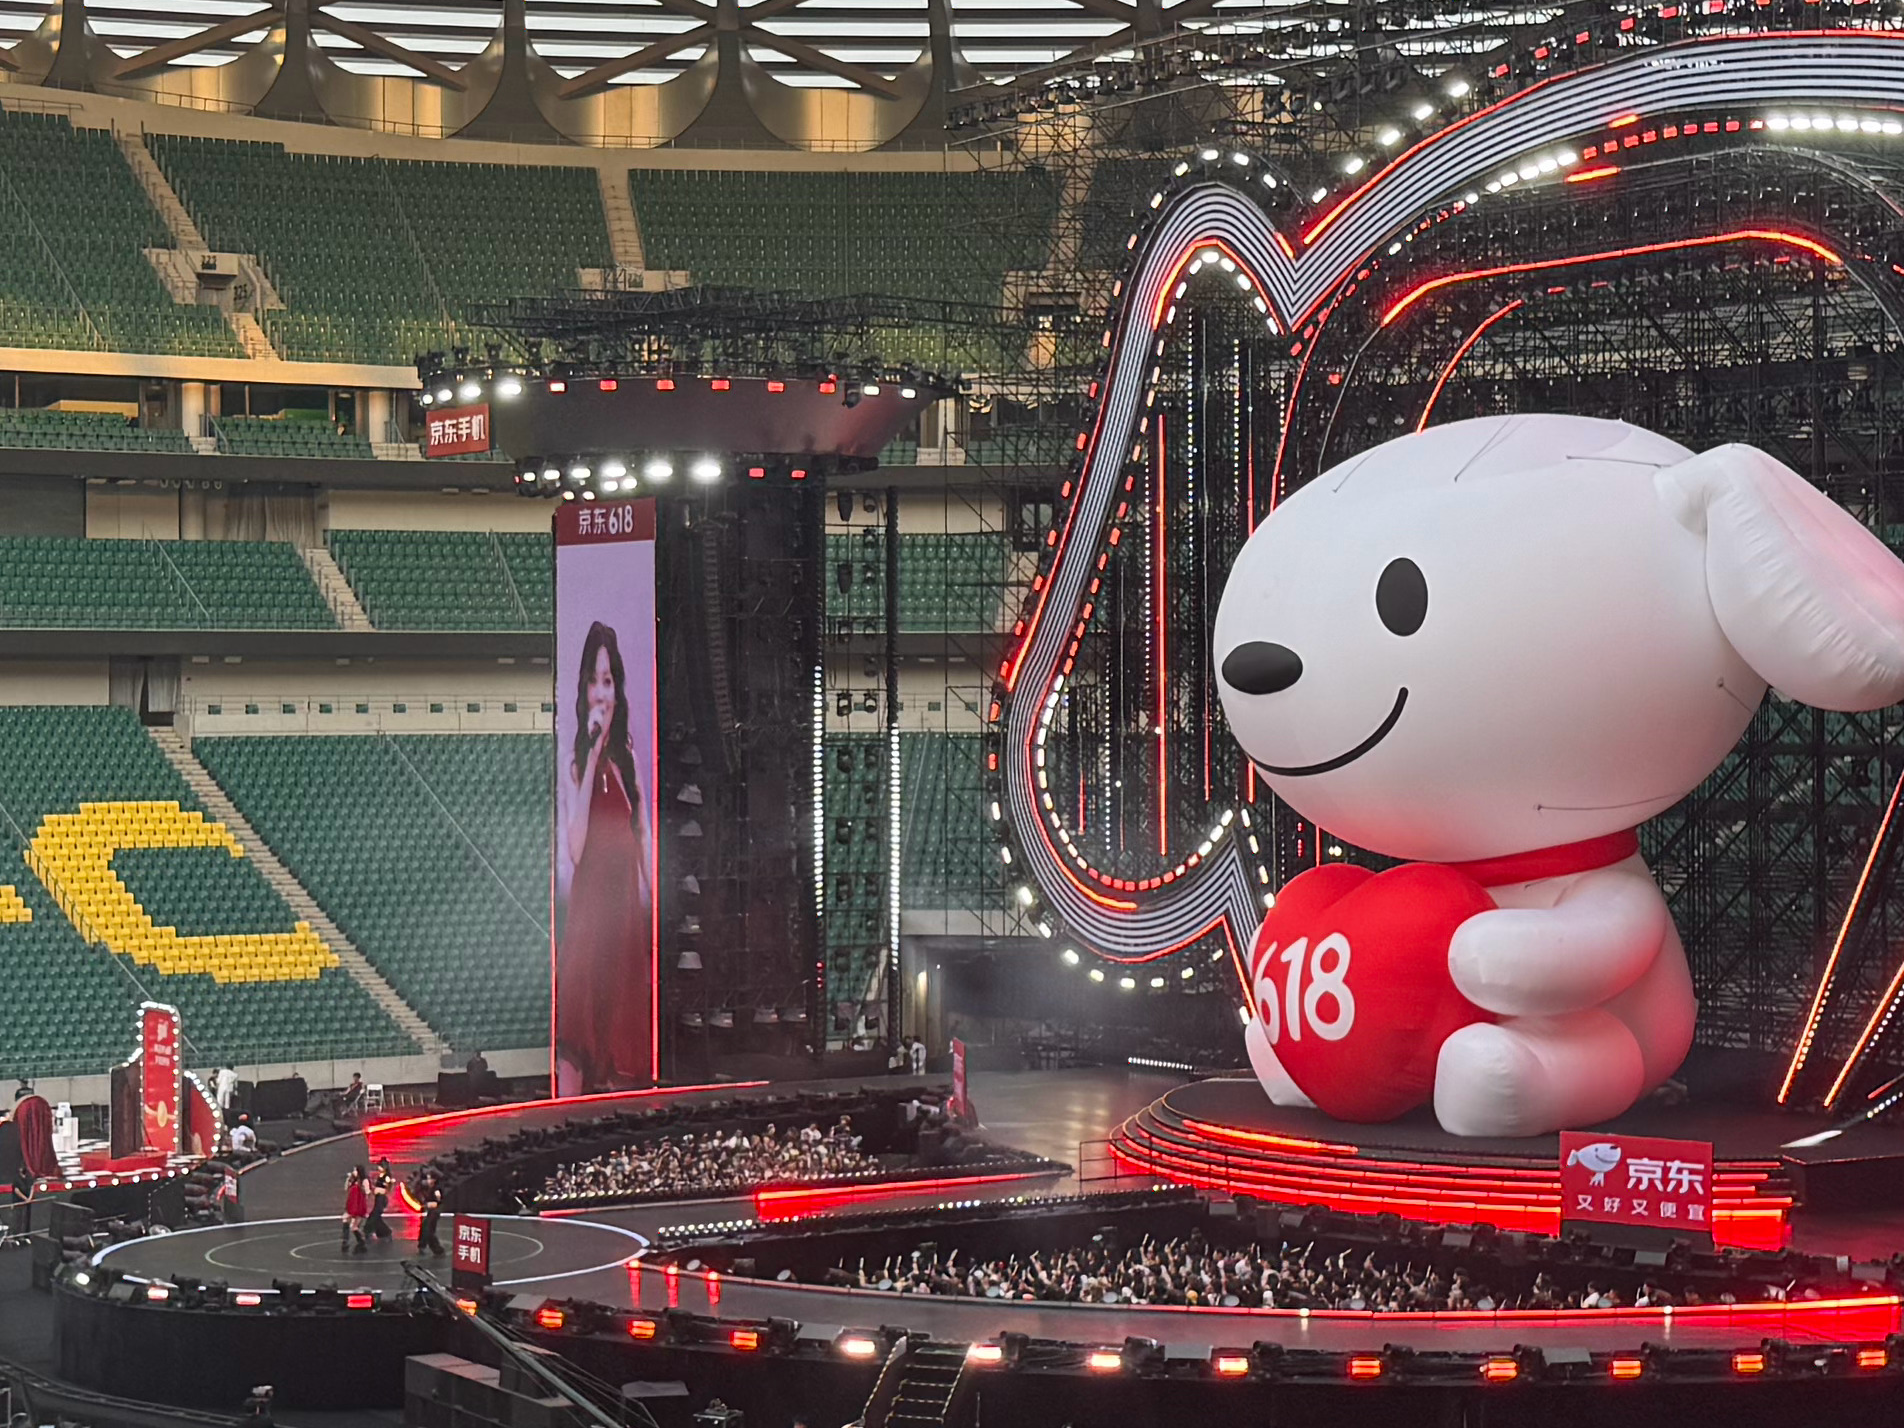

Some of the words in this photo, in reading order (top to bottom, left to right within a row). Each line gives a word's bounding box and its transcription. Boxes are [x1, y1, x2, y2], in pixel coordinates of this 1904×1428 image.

[430, 414, 486, 446] 京东手机
[578, 504, 634, 535] 京东618
[1252, 931, 1356, 1046] 618
[1626, 1156, 1705, 1196] 京东
[1576, 1194, 1706, 1223] 又好又便宜
[458, 1225, 482, 1244] 京东
[457, 1245, 481, 1264] 手机
